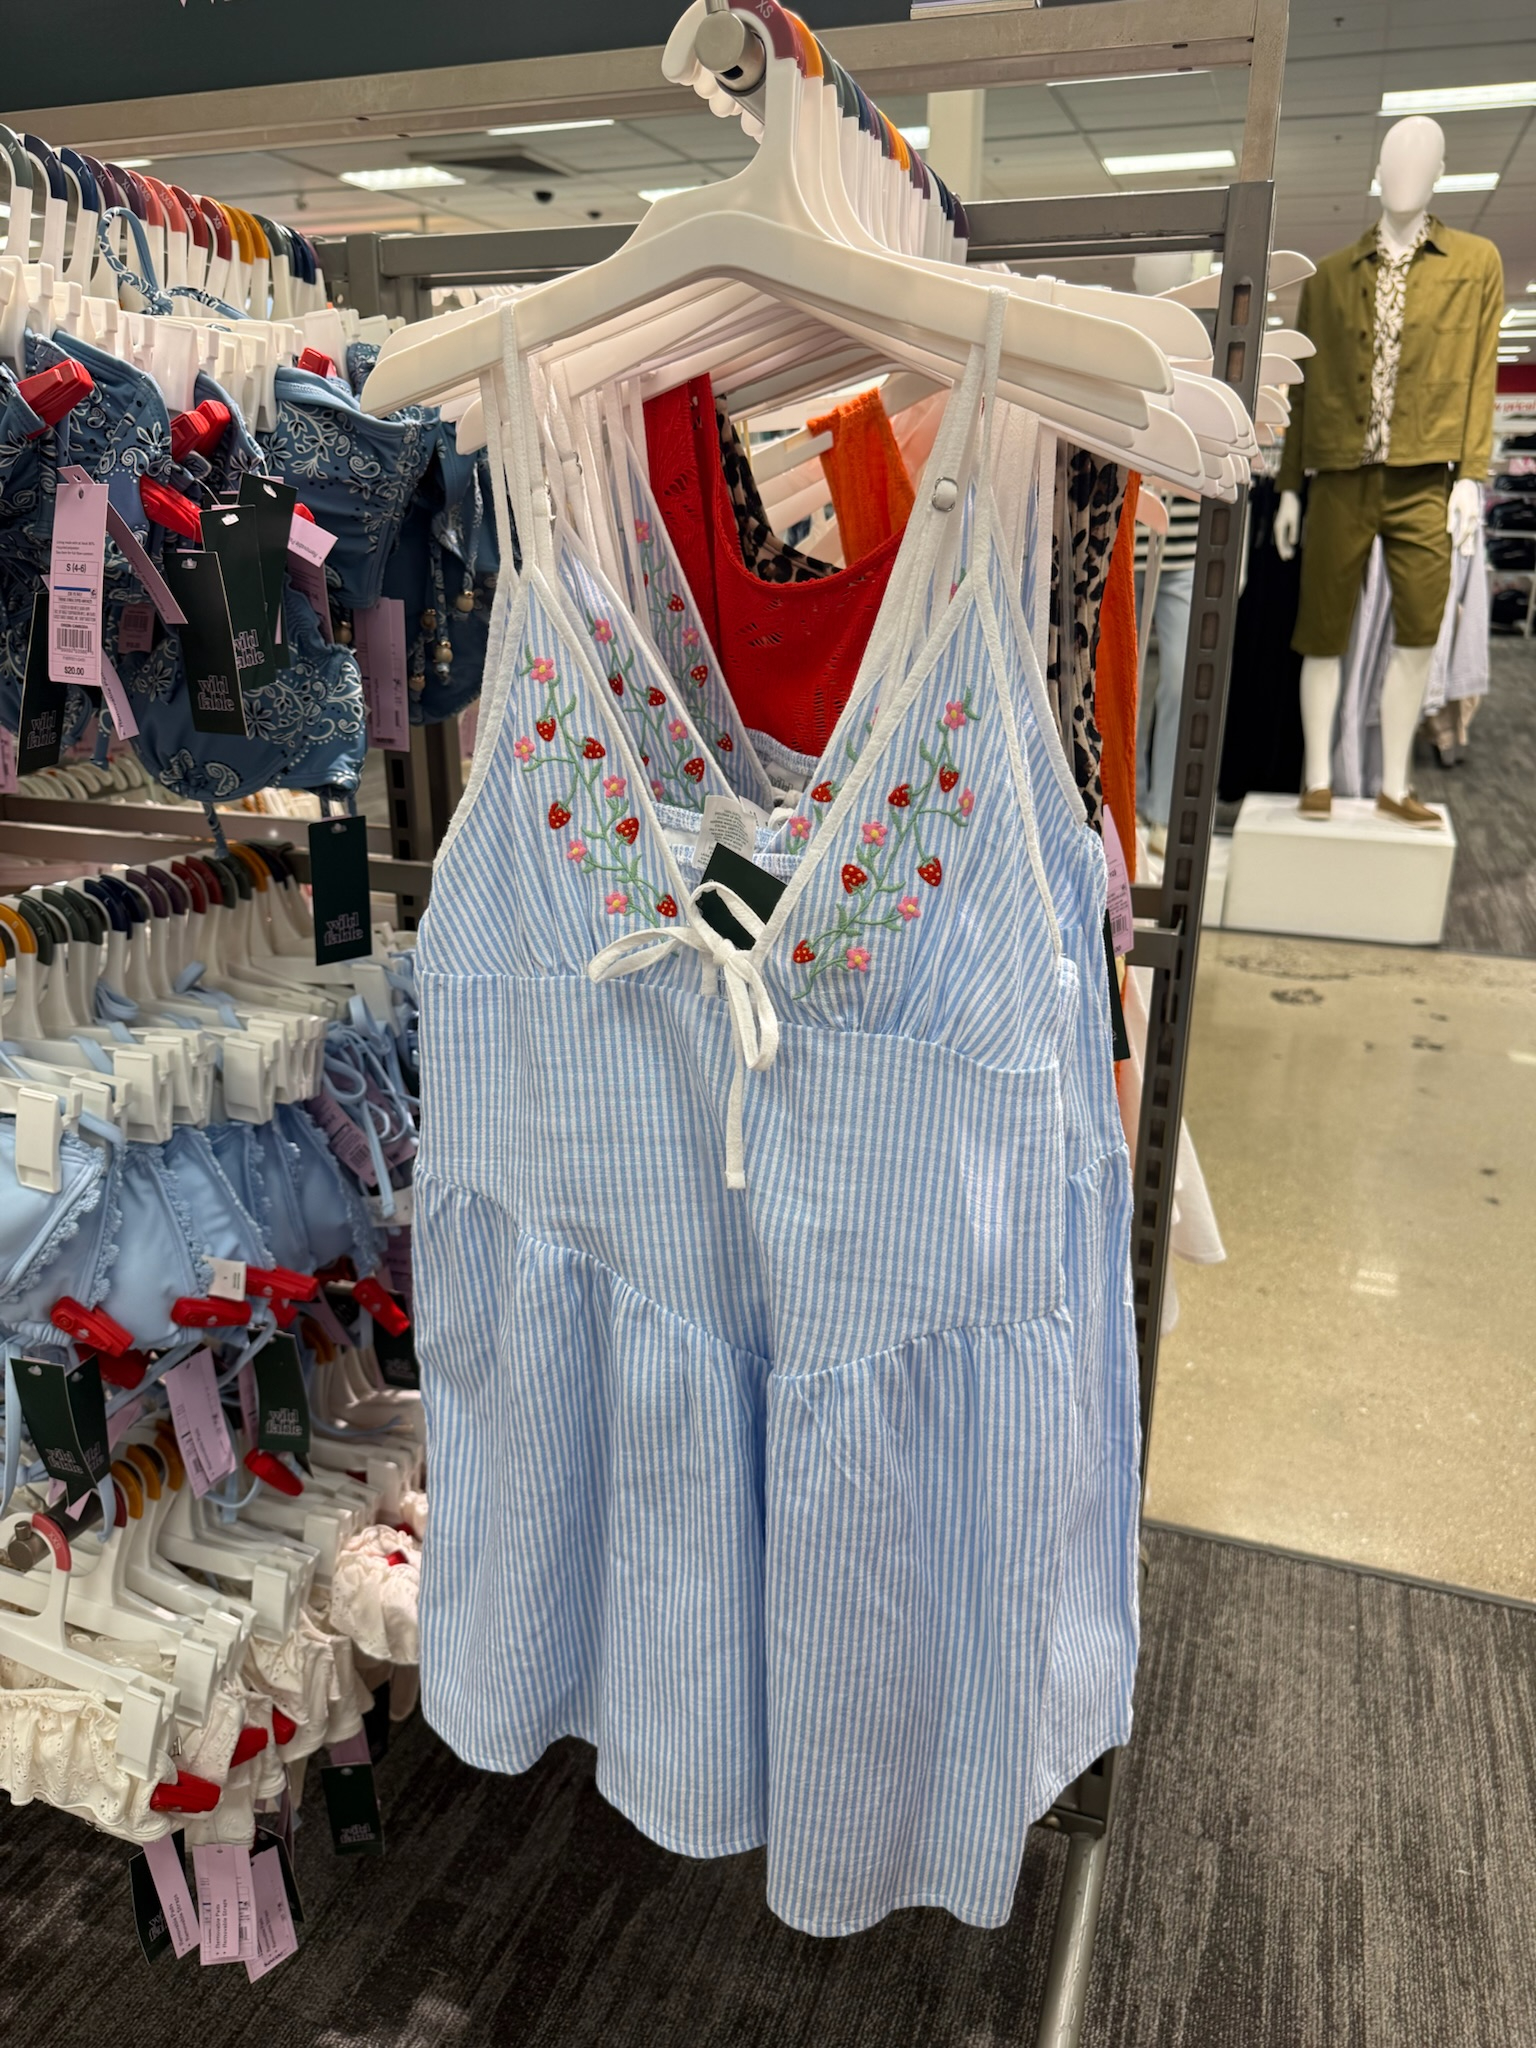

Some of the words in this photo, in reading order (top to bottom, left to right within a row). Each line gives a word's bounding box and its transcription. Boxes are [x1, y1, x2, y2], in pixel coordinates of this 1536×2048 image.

[755, 0, 774, 19] XS
[7, 141, 15, 155] M
[44, 157, 51, 167] L
[77, 166, 83, 177] L
[97, 172, 107, 188] XL
[66, 563, 72, 572] S
[72, 563, 87, 574] (4-6)
[235, 648, 265, 670] able
[64, 666, 85, 676] $20.00
[197, 675, 229, 694] wild
[197, 691, 235, 712] fable
[31, 711, 57, 732] wild
[26, 728, 58, 750] fable
[326, 912, 360, 930] wild
[324, 927, 364, 946] fable
[268, 1407, 300, 1424] wild
[265, 1420, 303, 1436] fable
